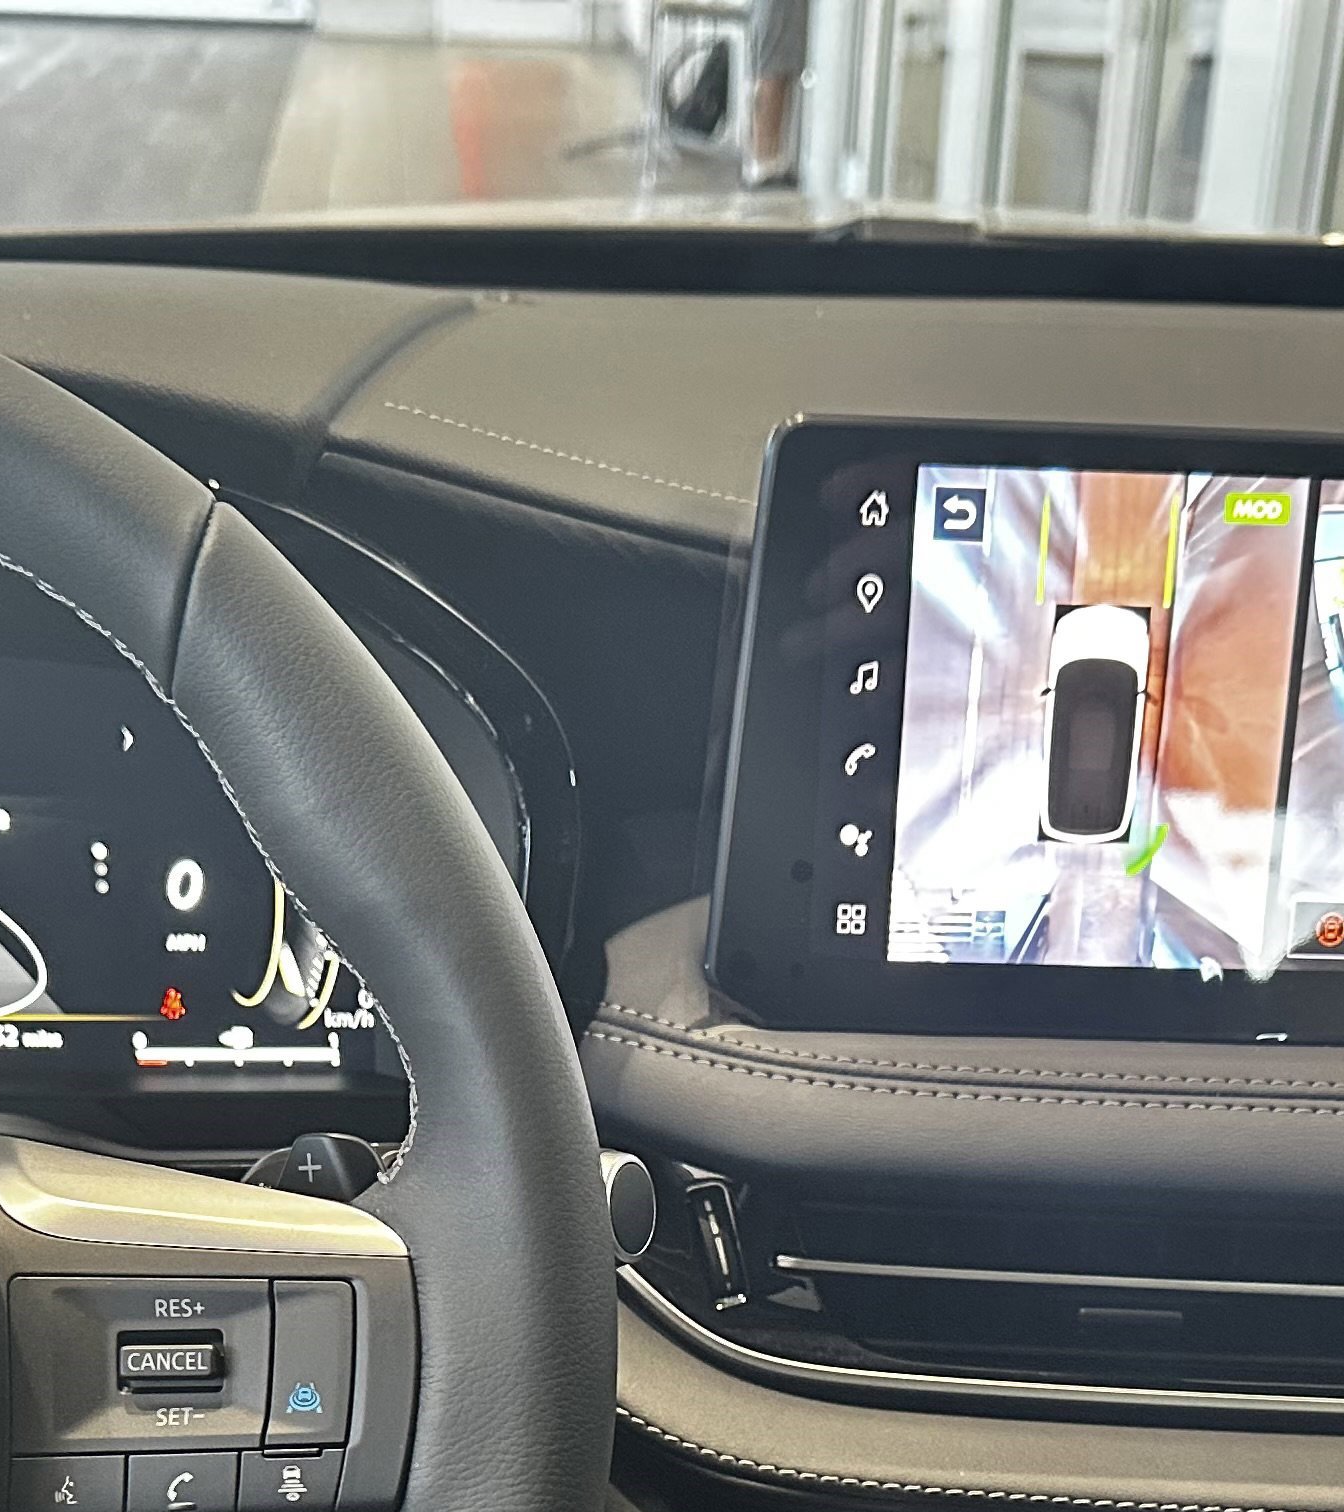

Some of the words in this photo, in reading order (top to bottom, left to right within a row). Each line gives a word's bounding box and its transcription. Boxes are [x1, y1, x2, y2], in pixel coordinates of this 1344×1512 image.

[1233, 499, 1282, 519] MOD
[166, 858, 205, 911] 0
[154, 1298, 206, 1318] RES+
[127, 1350, 208, 1371] CANCEL
